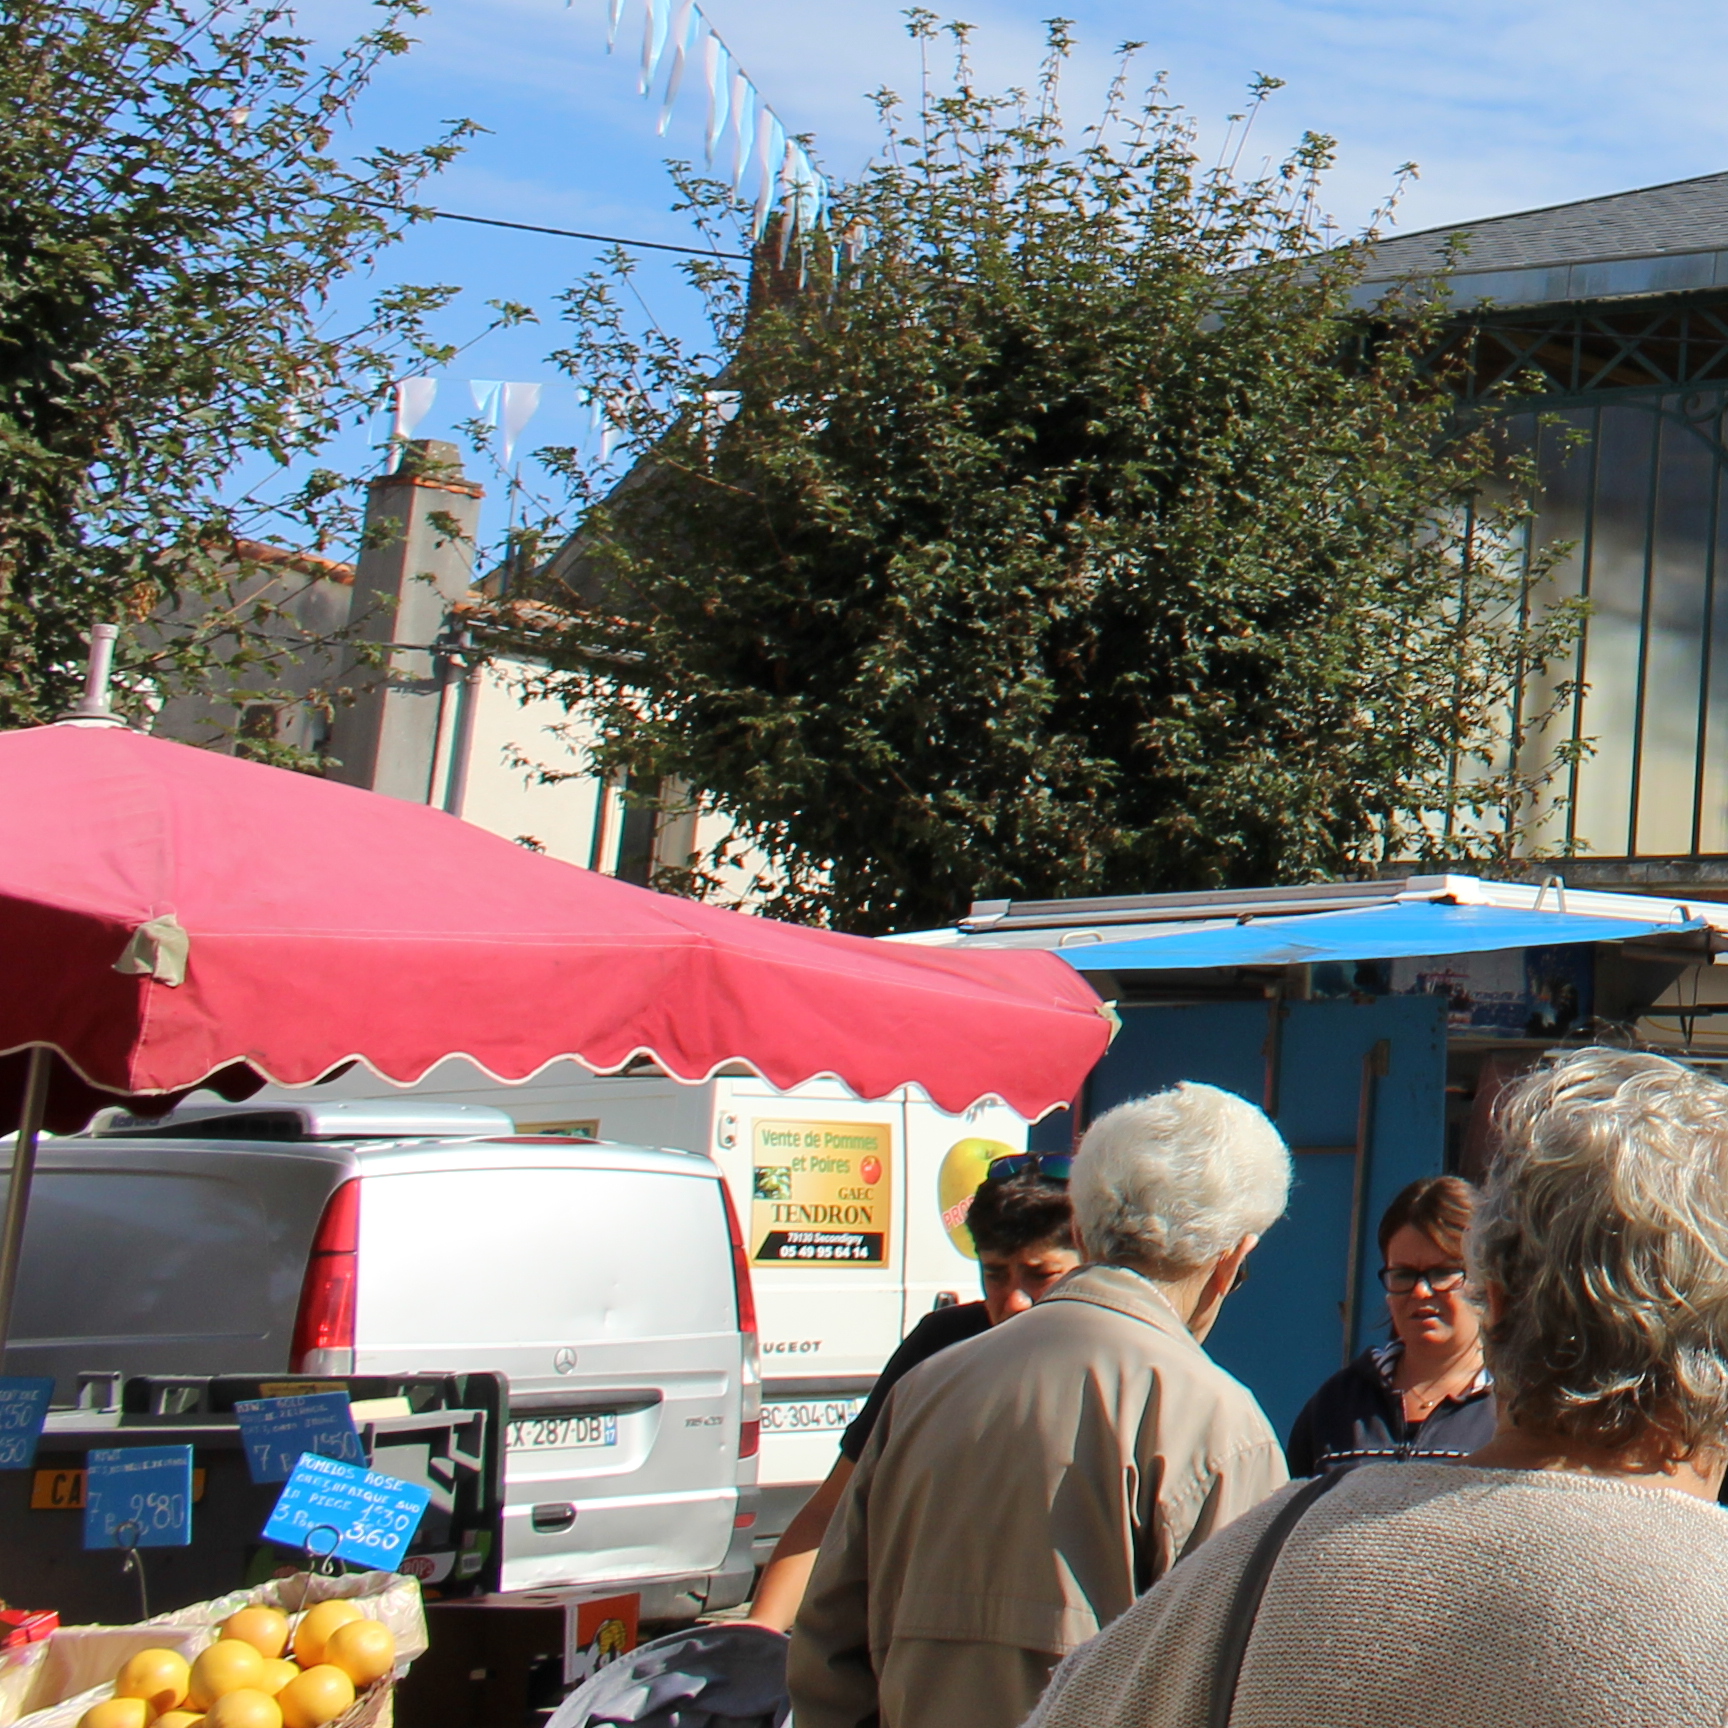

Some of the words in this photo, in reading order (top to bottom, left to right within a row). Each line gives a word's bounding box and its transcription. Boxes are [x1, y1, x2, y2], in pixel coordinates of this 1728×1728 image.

[762, 1129, 800, 1147] Vente
[804, 1131, 821, 1147] de
[824, 1132, 878, 1150] Pommes
[792, 1156, 807, 1172] et
[810, 1155, 851, 1174] Poires
[837, 1187, 874, 1201] GAEC
[771, 1203, 874, 1225] TENDRON
[779, 1245, 797, 1259] 05
[798, 1245, 815, 1259] 49
[815, 1245, 833, 1259] 95
[833, 1245, 851, 1259] 64
[851, 1245, 869, 1259] 14
[299, 1455, 356, 1480] POMELOS
[364, 1471, 407, 1492] ROSE
